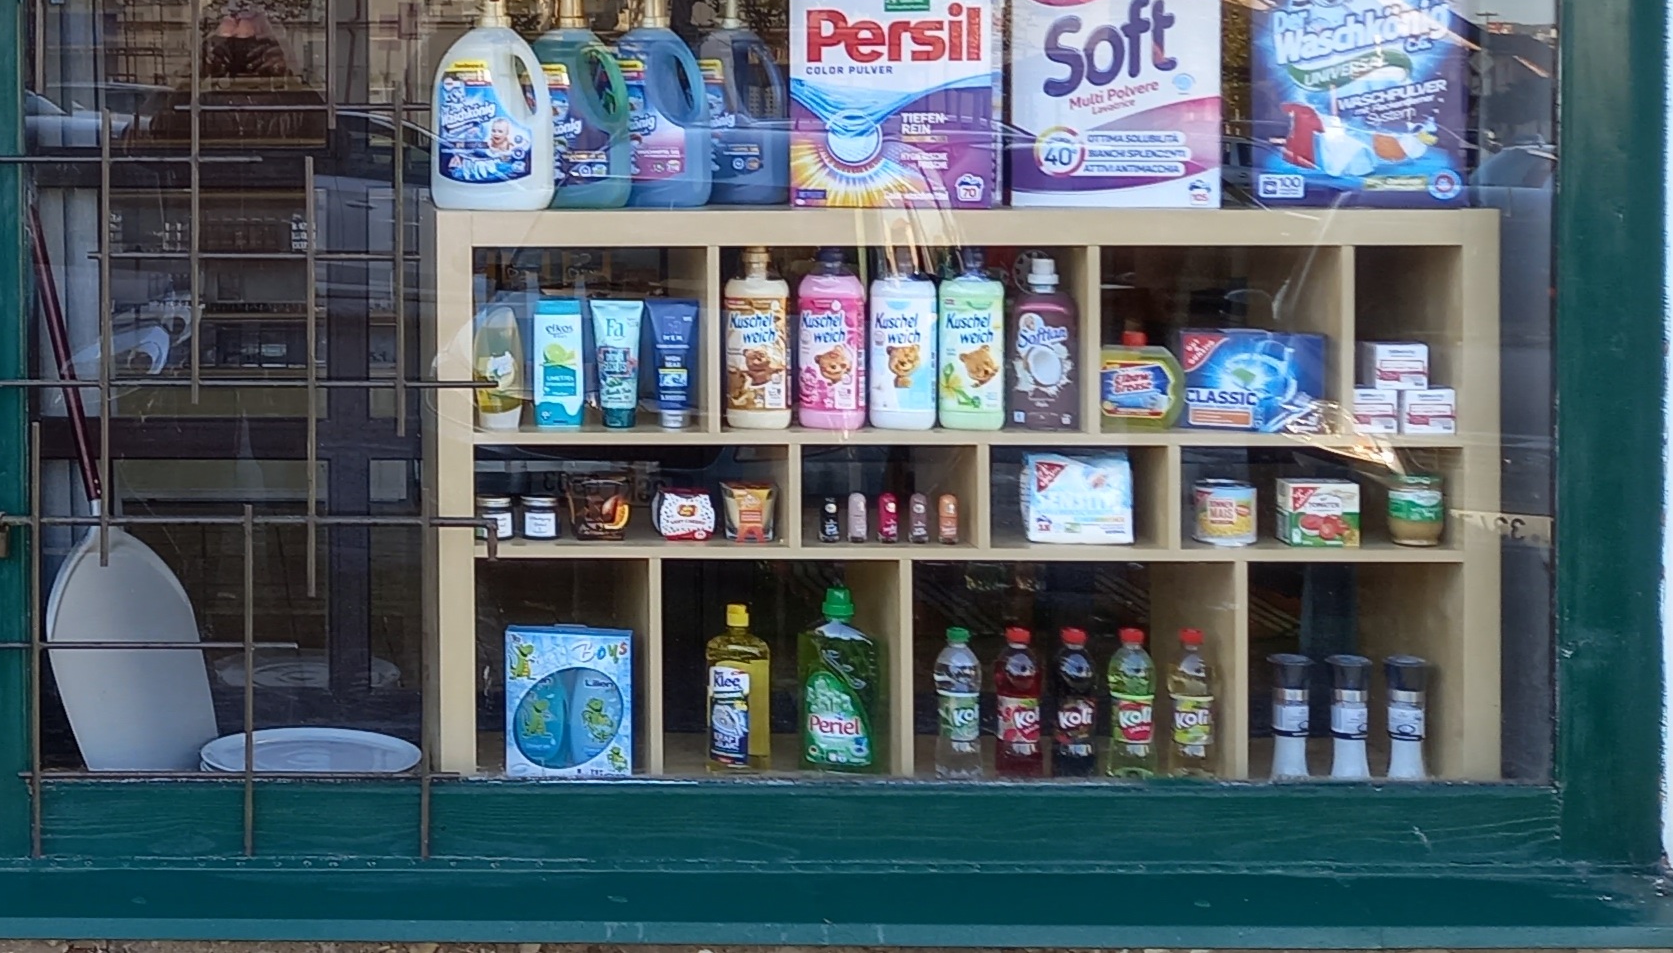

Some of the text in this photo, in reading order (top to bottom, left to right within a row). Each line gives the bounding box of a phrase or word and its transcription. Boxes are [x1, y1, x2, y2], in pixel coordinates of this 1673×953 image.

[805, 2, 982, 63] Persil
[805, 65, 894, 75] COLOR PULVER
[901, 124, 931, 135] REIN
[605, 318, 626, 337] Fa
[730, 313, 773, 329] Kuschel
[801, 312, 843, 328] Kuschel
[875, 313, 919, 329] Kuschel
[945, 313, 991, 329] Kuschel
[742, 328, 776, 344] weich
[813, 328, 846, 344] weich
[887, 329, 921, 344] weich
[960, 328, 994, 344] weich
[1185, 389, 1257, 406] CLASSIC
